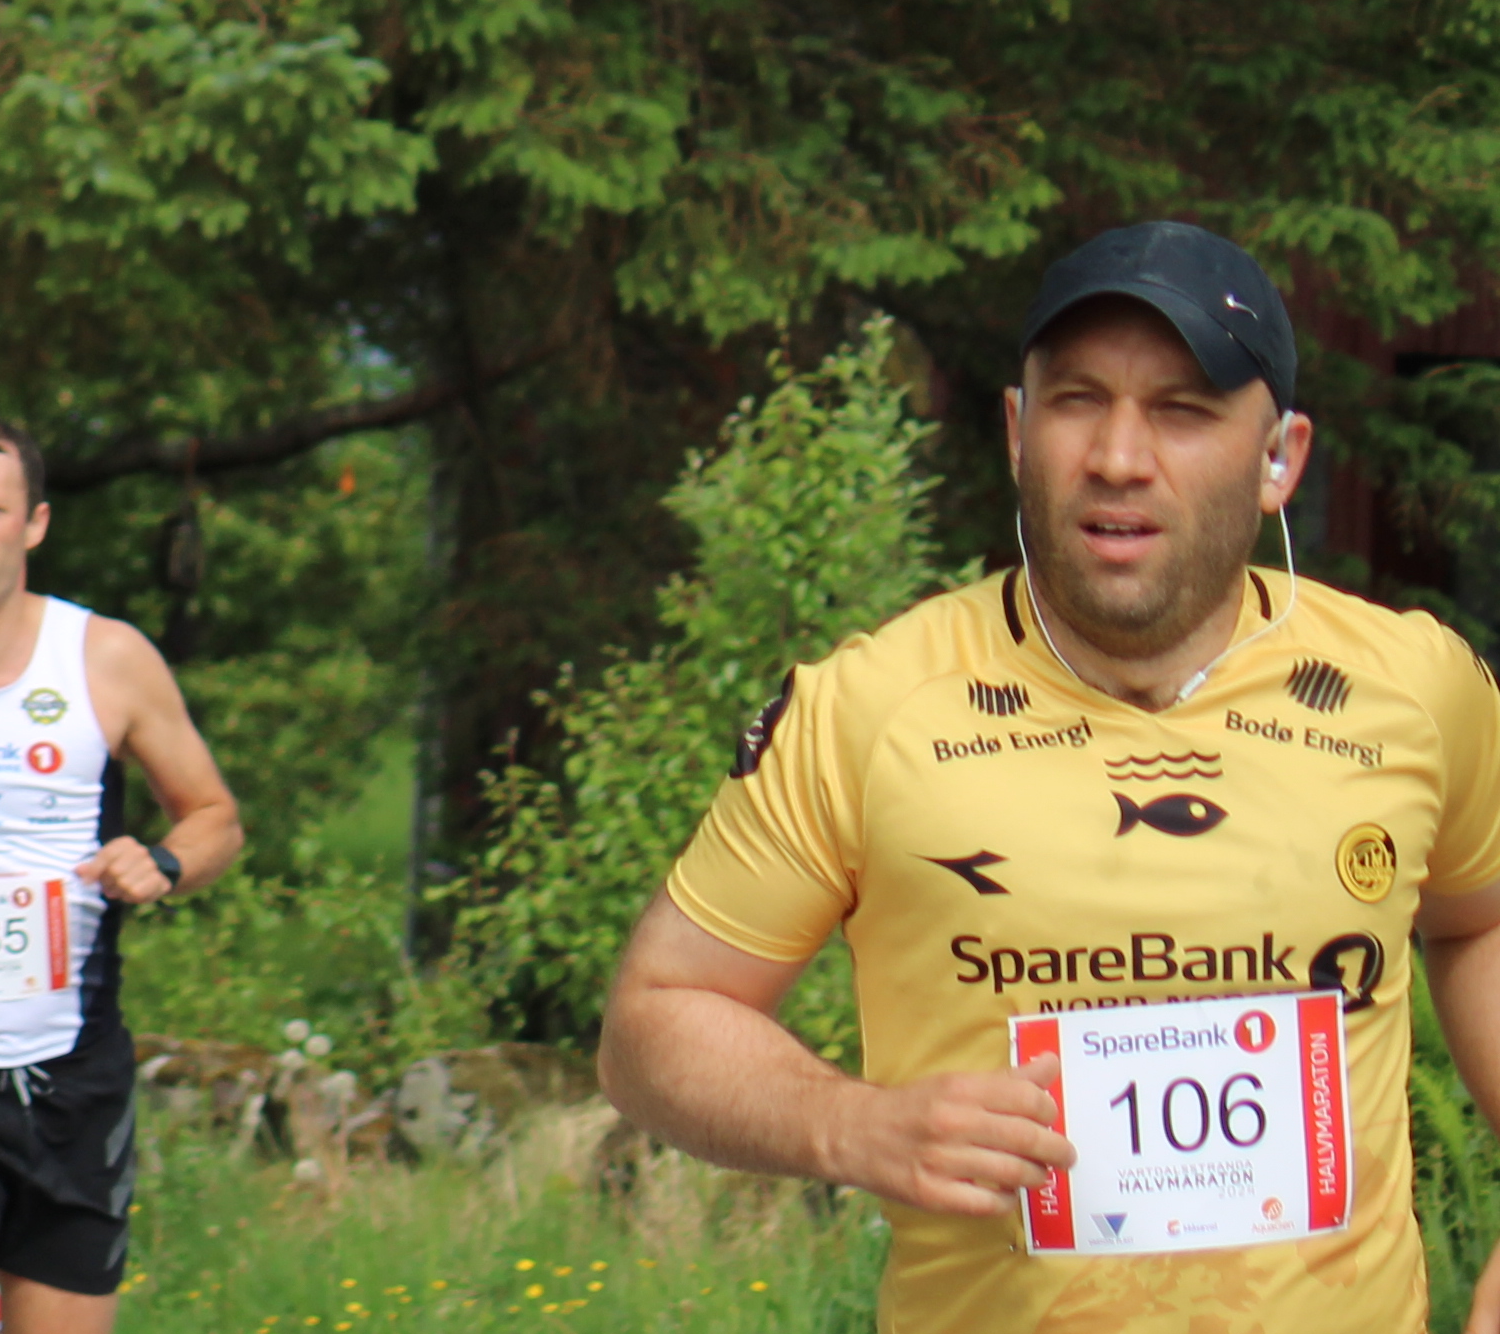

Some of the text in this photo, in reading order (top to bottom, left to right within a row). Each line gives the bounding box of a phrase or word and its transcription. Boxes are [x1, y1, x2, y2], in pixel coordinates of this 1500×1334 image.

[933, 717, 1094, 763] Bodø Energi
[1225, 709, 1384, 767] Bodø Energi
[951, 932, 1296, 994] SpareBank
[1083, 1023, 1228, 1058] SpareBank
[1109, 1072, 1267, 1156] 106
[1310, 1032, 1336, 1196] HALVMARATON
[1119, 1170, 1253, 1194] HALVMARATON
